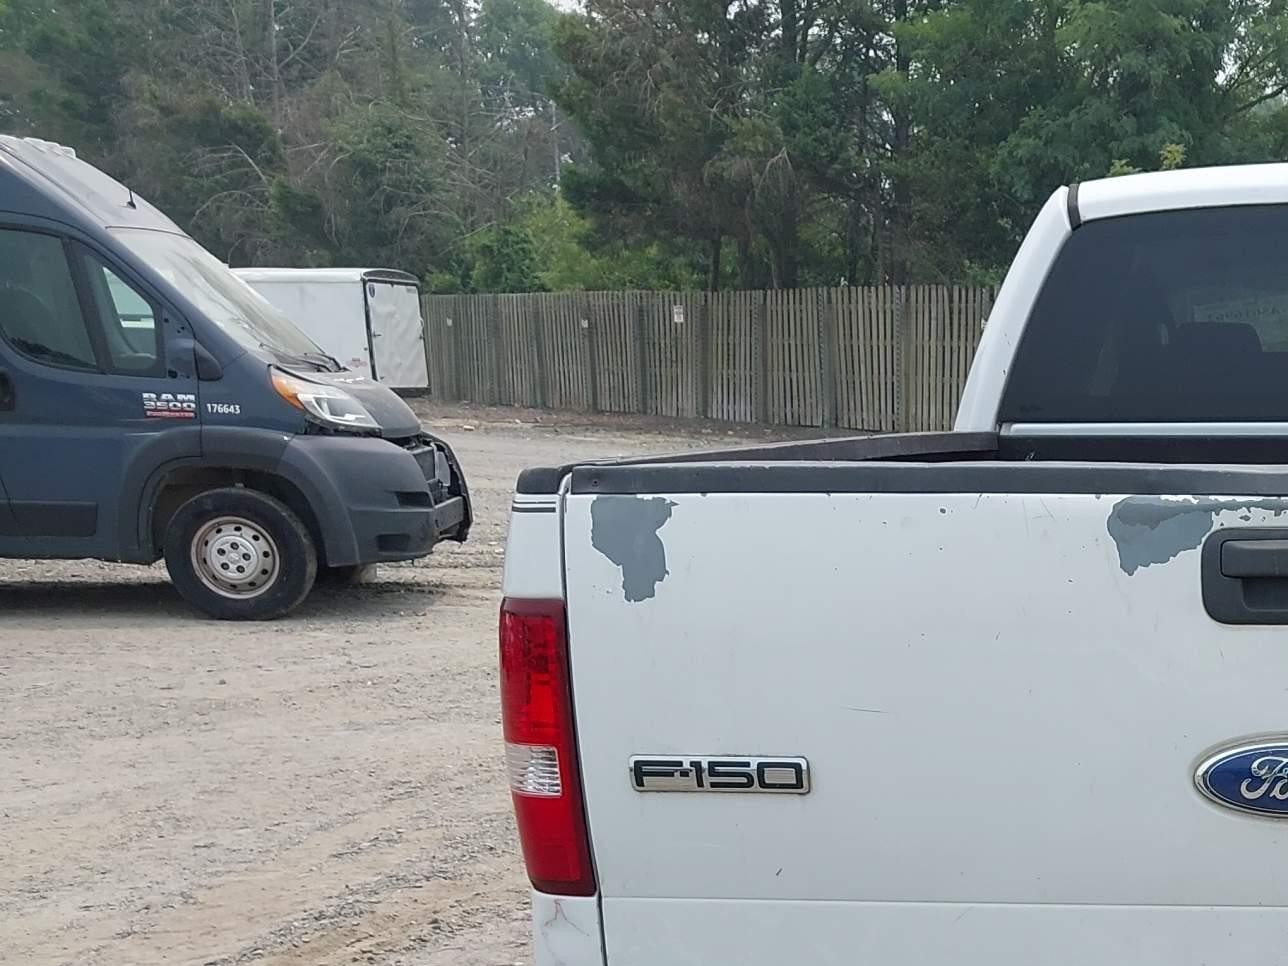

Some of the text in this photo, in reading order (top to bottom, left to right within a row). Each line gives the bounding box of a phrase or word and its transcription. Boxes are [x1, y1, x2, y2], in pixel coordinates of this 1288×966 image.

[142, 392, 196, 402] RAM
[143, 401, 196, 411] 3500
[206, 403, 241, 415] 176643
[633, 760, 805, 790] F-150
